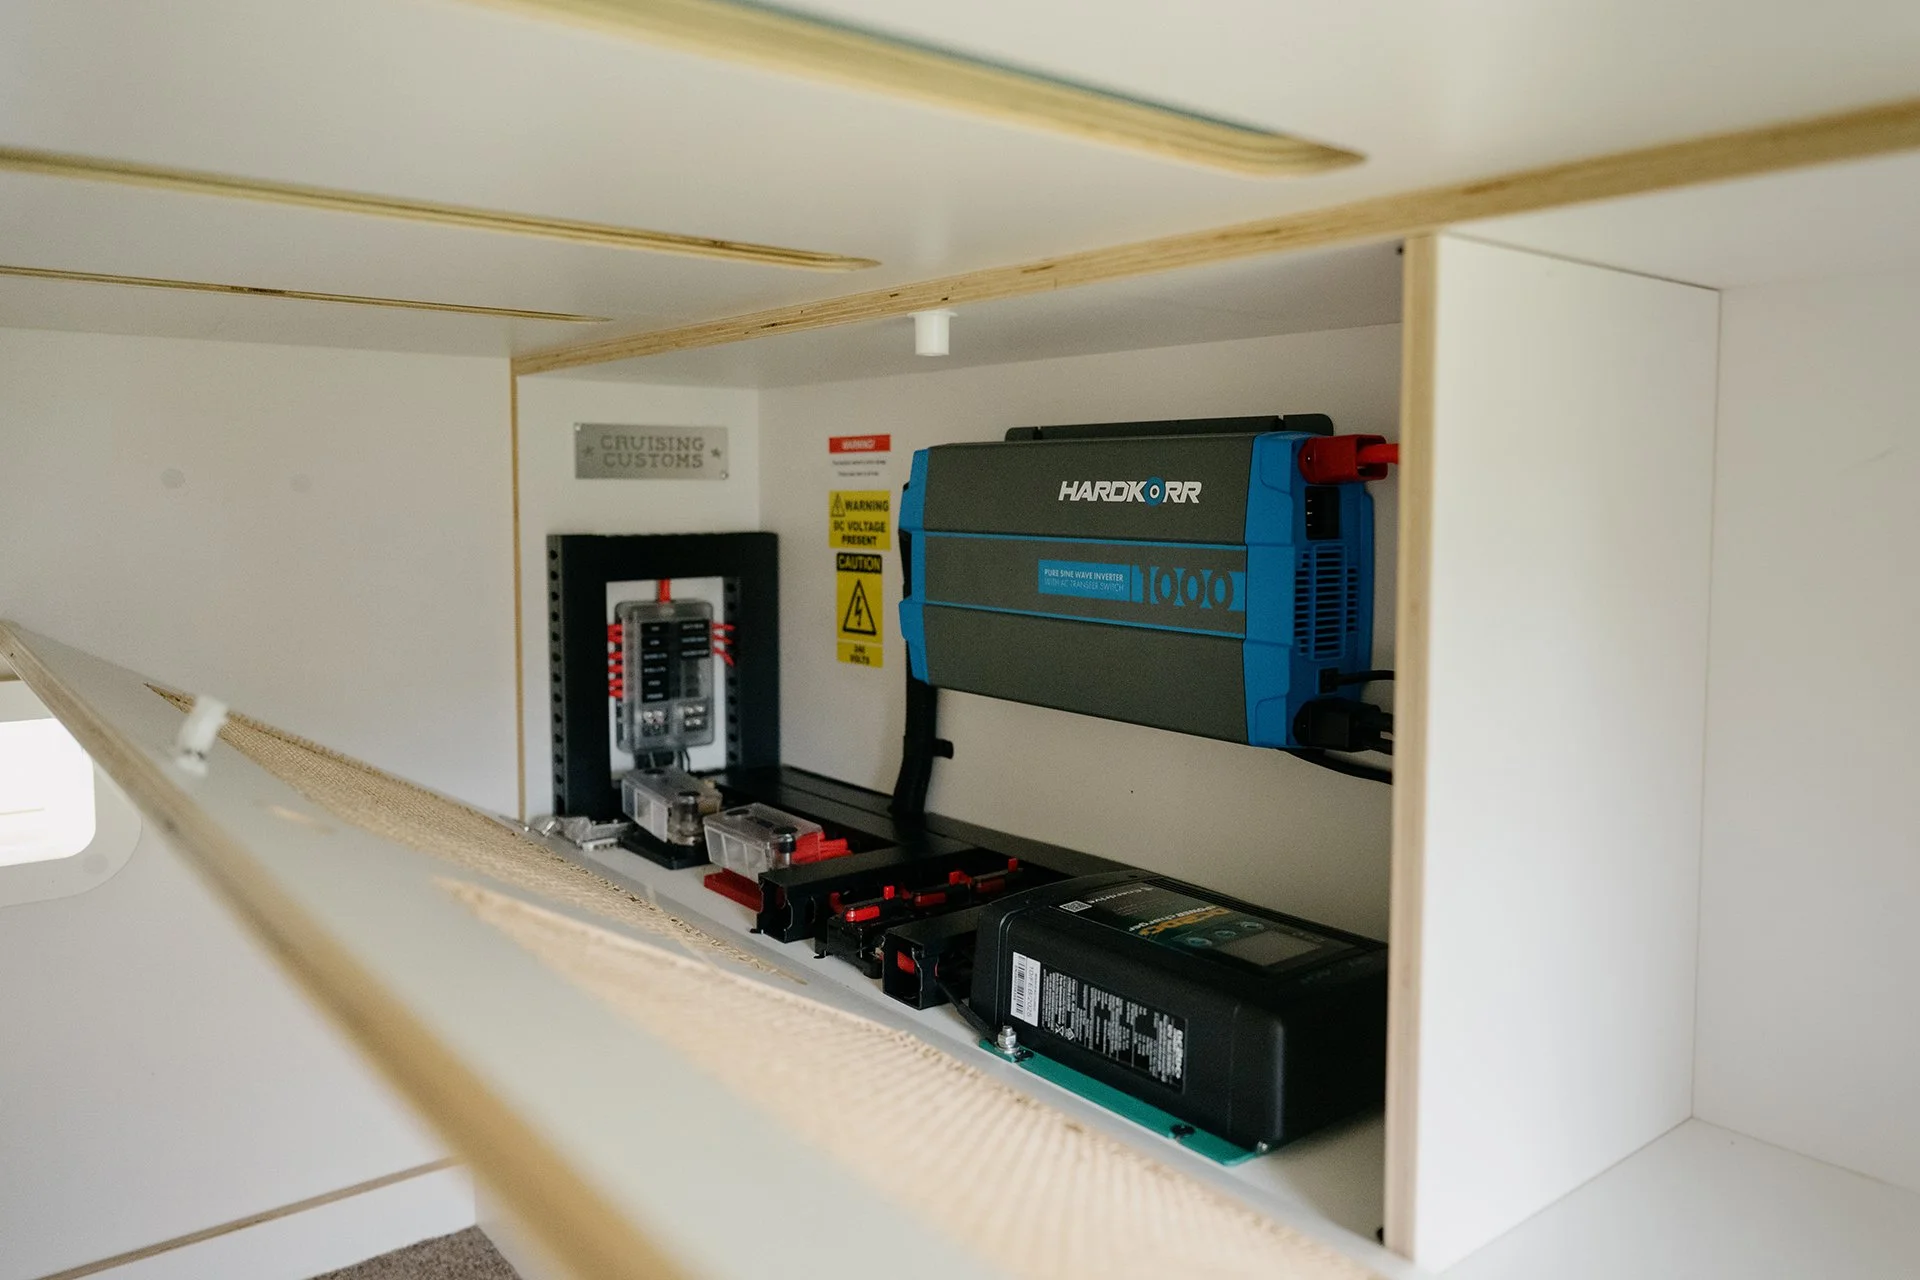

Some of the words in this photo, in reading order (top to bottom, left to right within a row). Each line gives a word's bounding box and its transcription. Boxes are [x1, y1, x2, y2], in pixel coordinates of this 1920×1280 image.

[600, 434, 705, 451] CRUISING
[602, 453, 704, 468] CUSTOMS
[1058, 478, 1202, 505] HARDKORR
[845, 500, 889, 512] WARNING
[833, 520, 845, 531] DC
[847, 521, 886, 533] VOLTAGE
[842, 535, 877, 545] PRESENT
[838, 554, 881, 572] CAUTION
[1044, 568, 1059, 577] PURE
[1060, 569, 1074, 578] SINE
[1075, 571, 1093, 580] WAVE
[1094, 572, 1124, 582] INVERTER
[1045, 578, 1060, 586] WITH
[1071, 580, 1098, 590] TRANSFER
[1100, 582, 1124, 592] SWITCH
[1138, 565, 1234, 611] 1000
